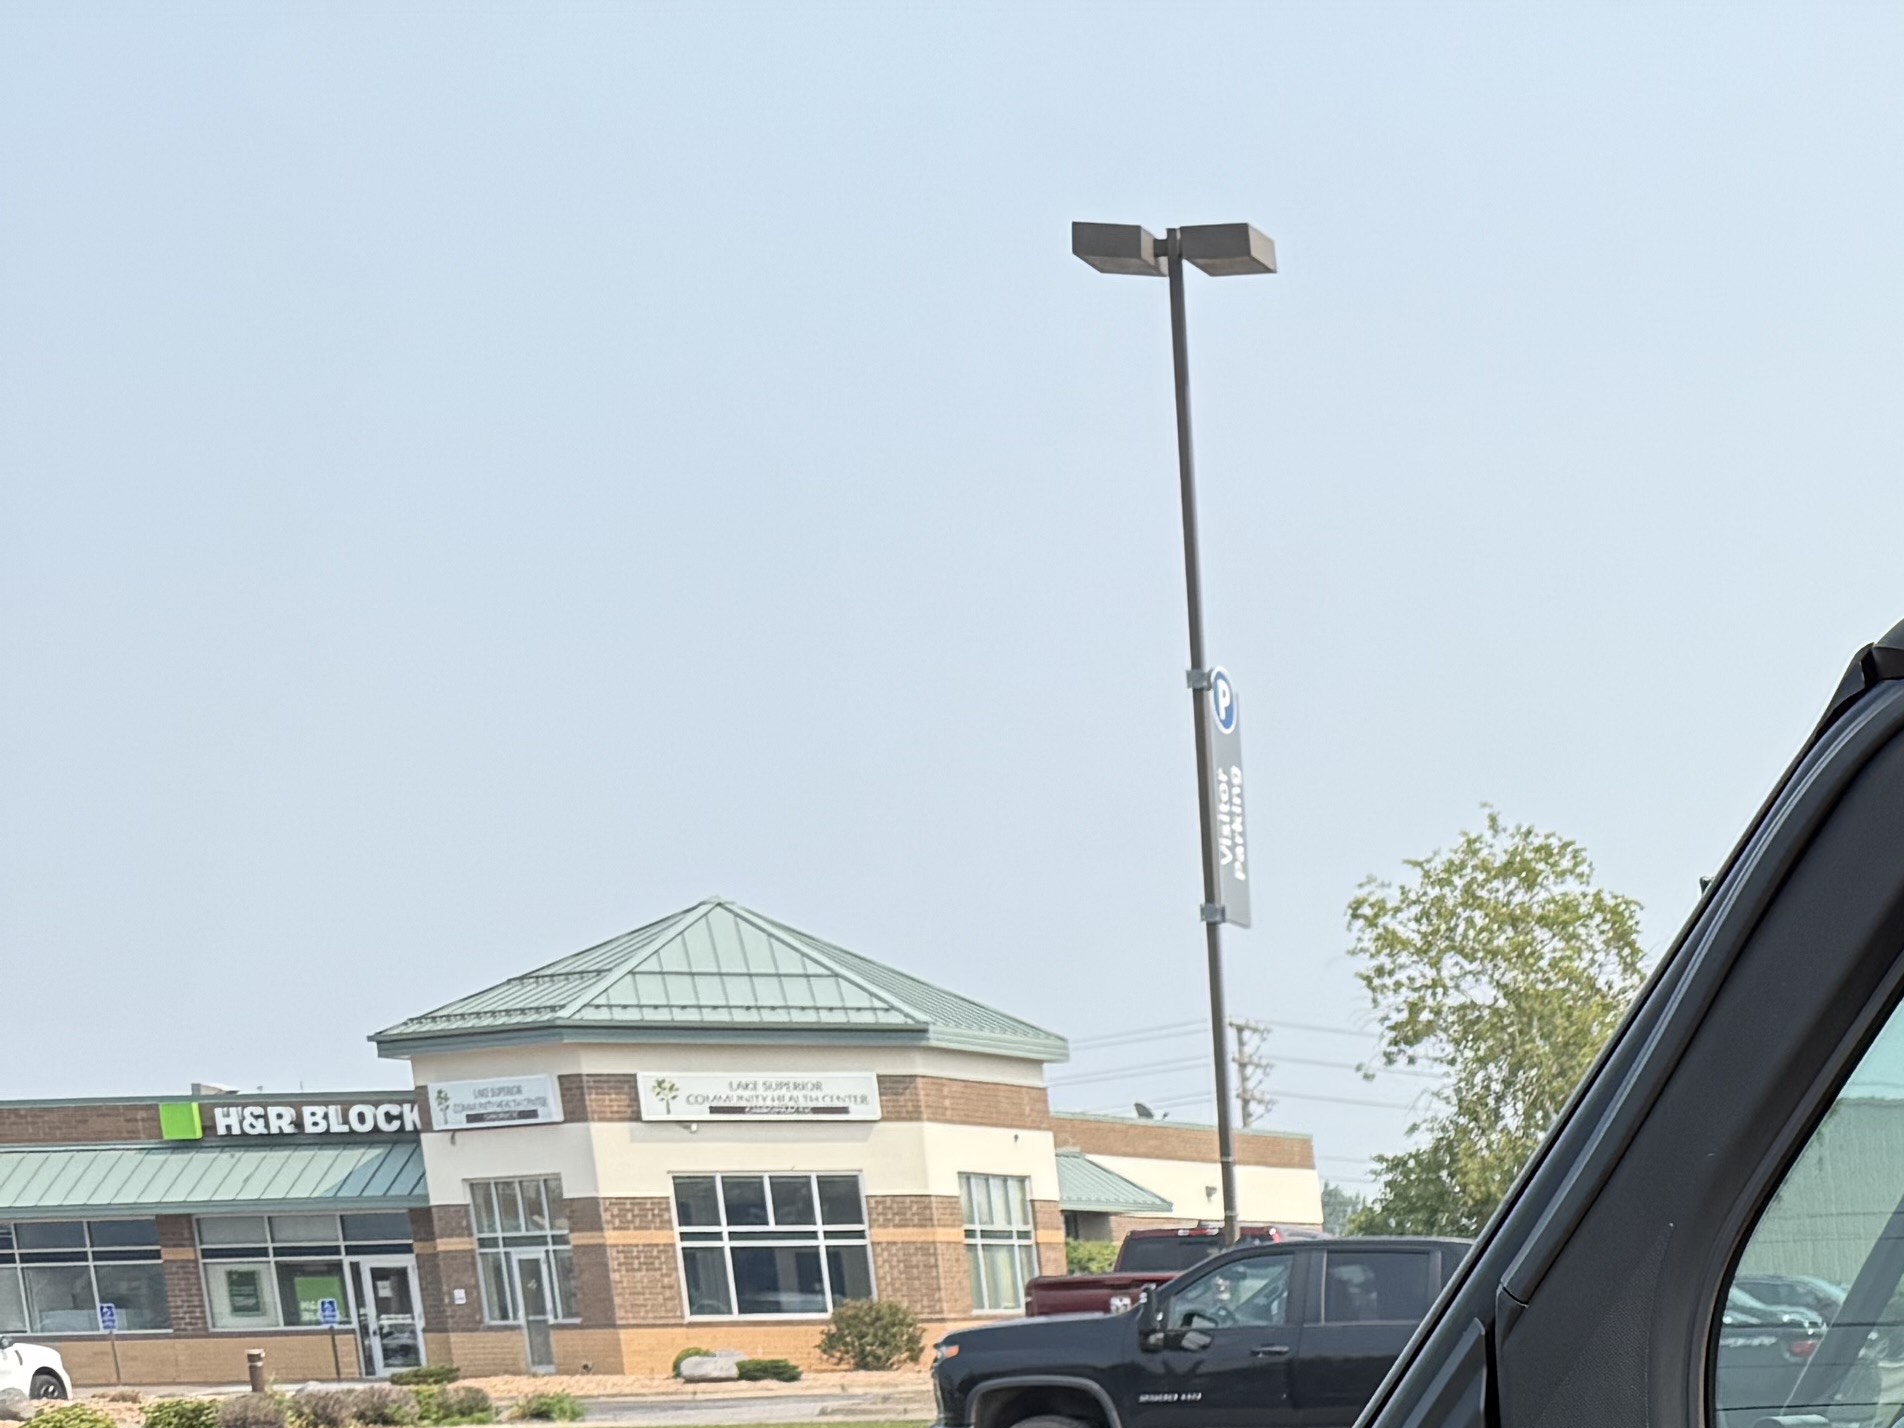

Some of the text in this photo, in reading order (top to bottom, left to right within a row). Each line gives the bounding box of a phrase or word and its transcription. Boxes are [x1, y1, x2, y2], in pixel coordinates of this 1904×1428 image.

[1217, 767, 1233, 865] Visitor
[1230, 765, 1247, 881] Parking
[214, 1103, 421, 1136] H&R BLOCK
